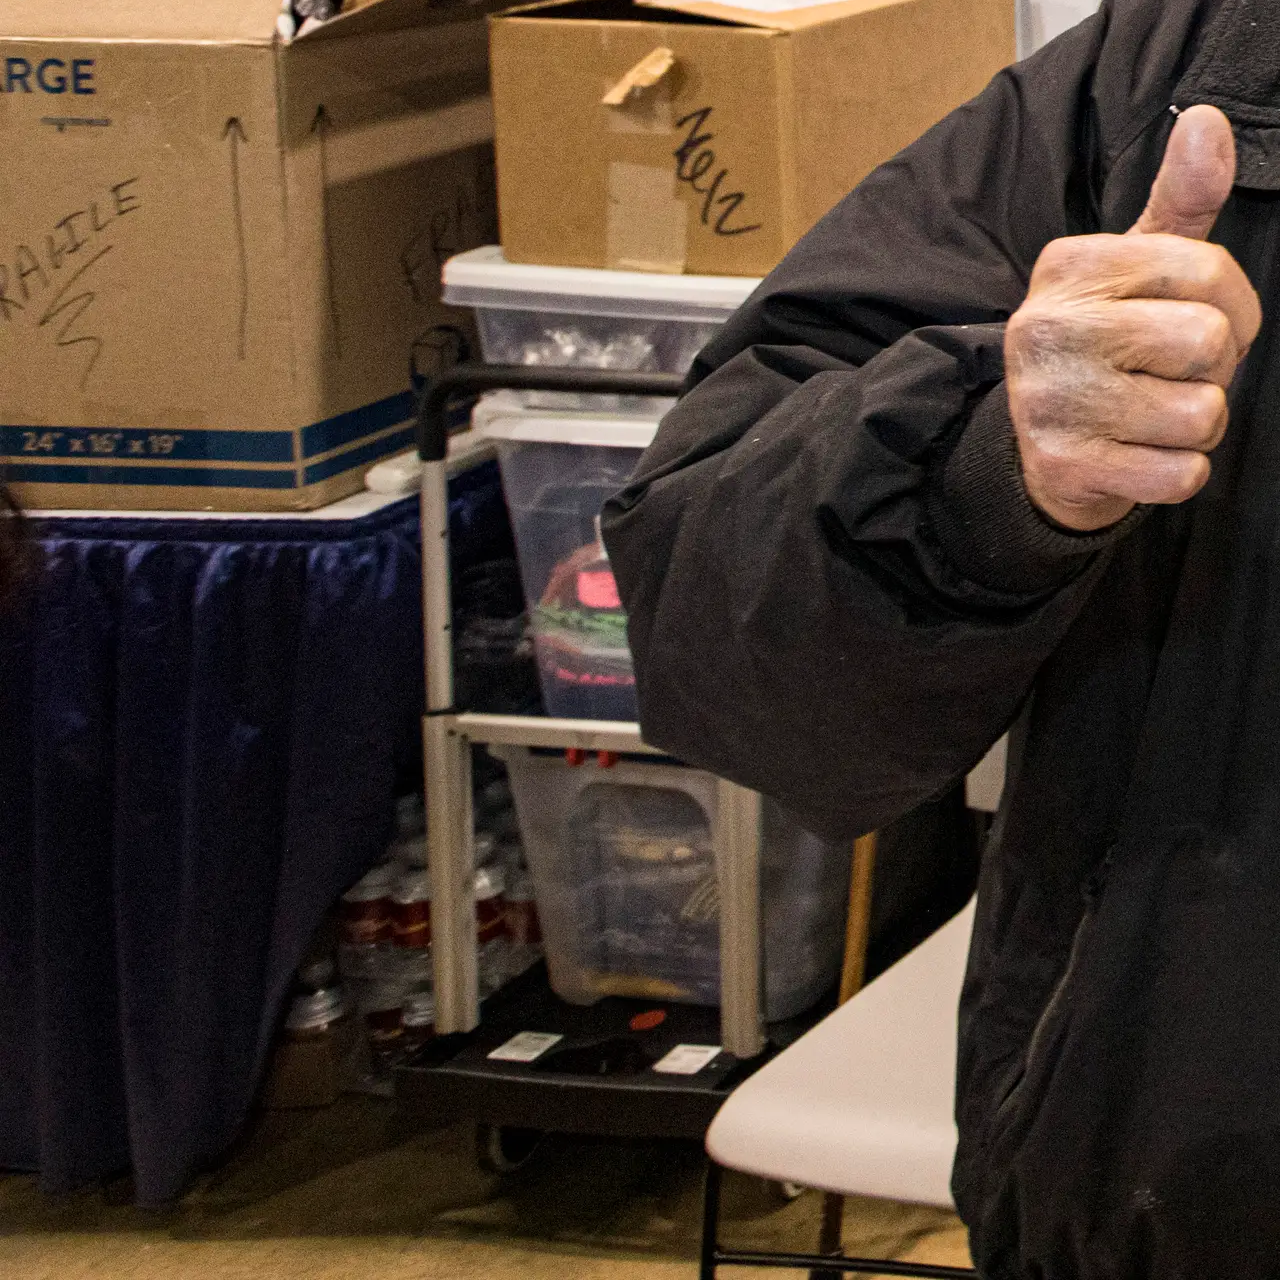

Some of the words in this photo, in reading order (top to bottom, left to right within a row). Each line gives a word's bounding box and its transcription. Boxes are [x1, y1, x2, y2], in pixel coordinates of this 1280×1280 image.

[0, 58, 96, 95] RGE
[69, 438, 86, 453] x
[128, 439, 146, 453] x
